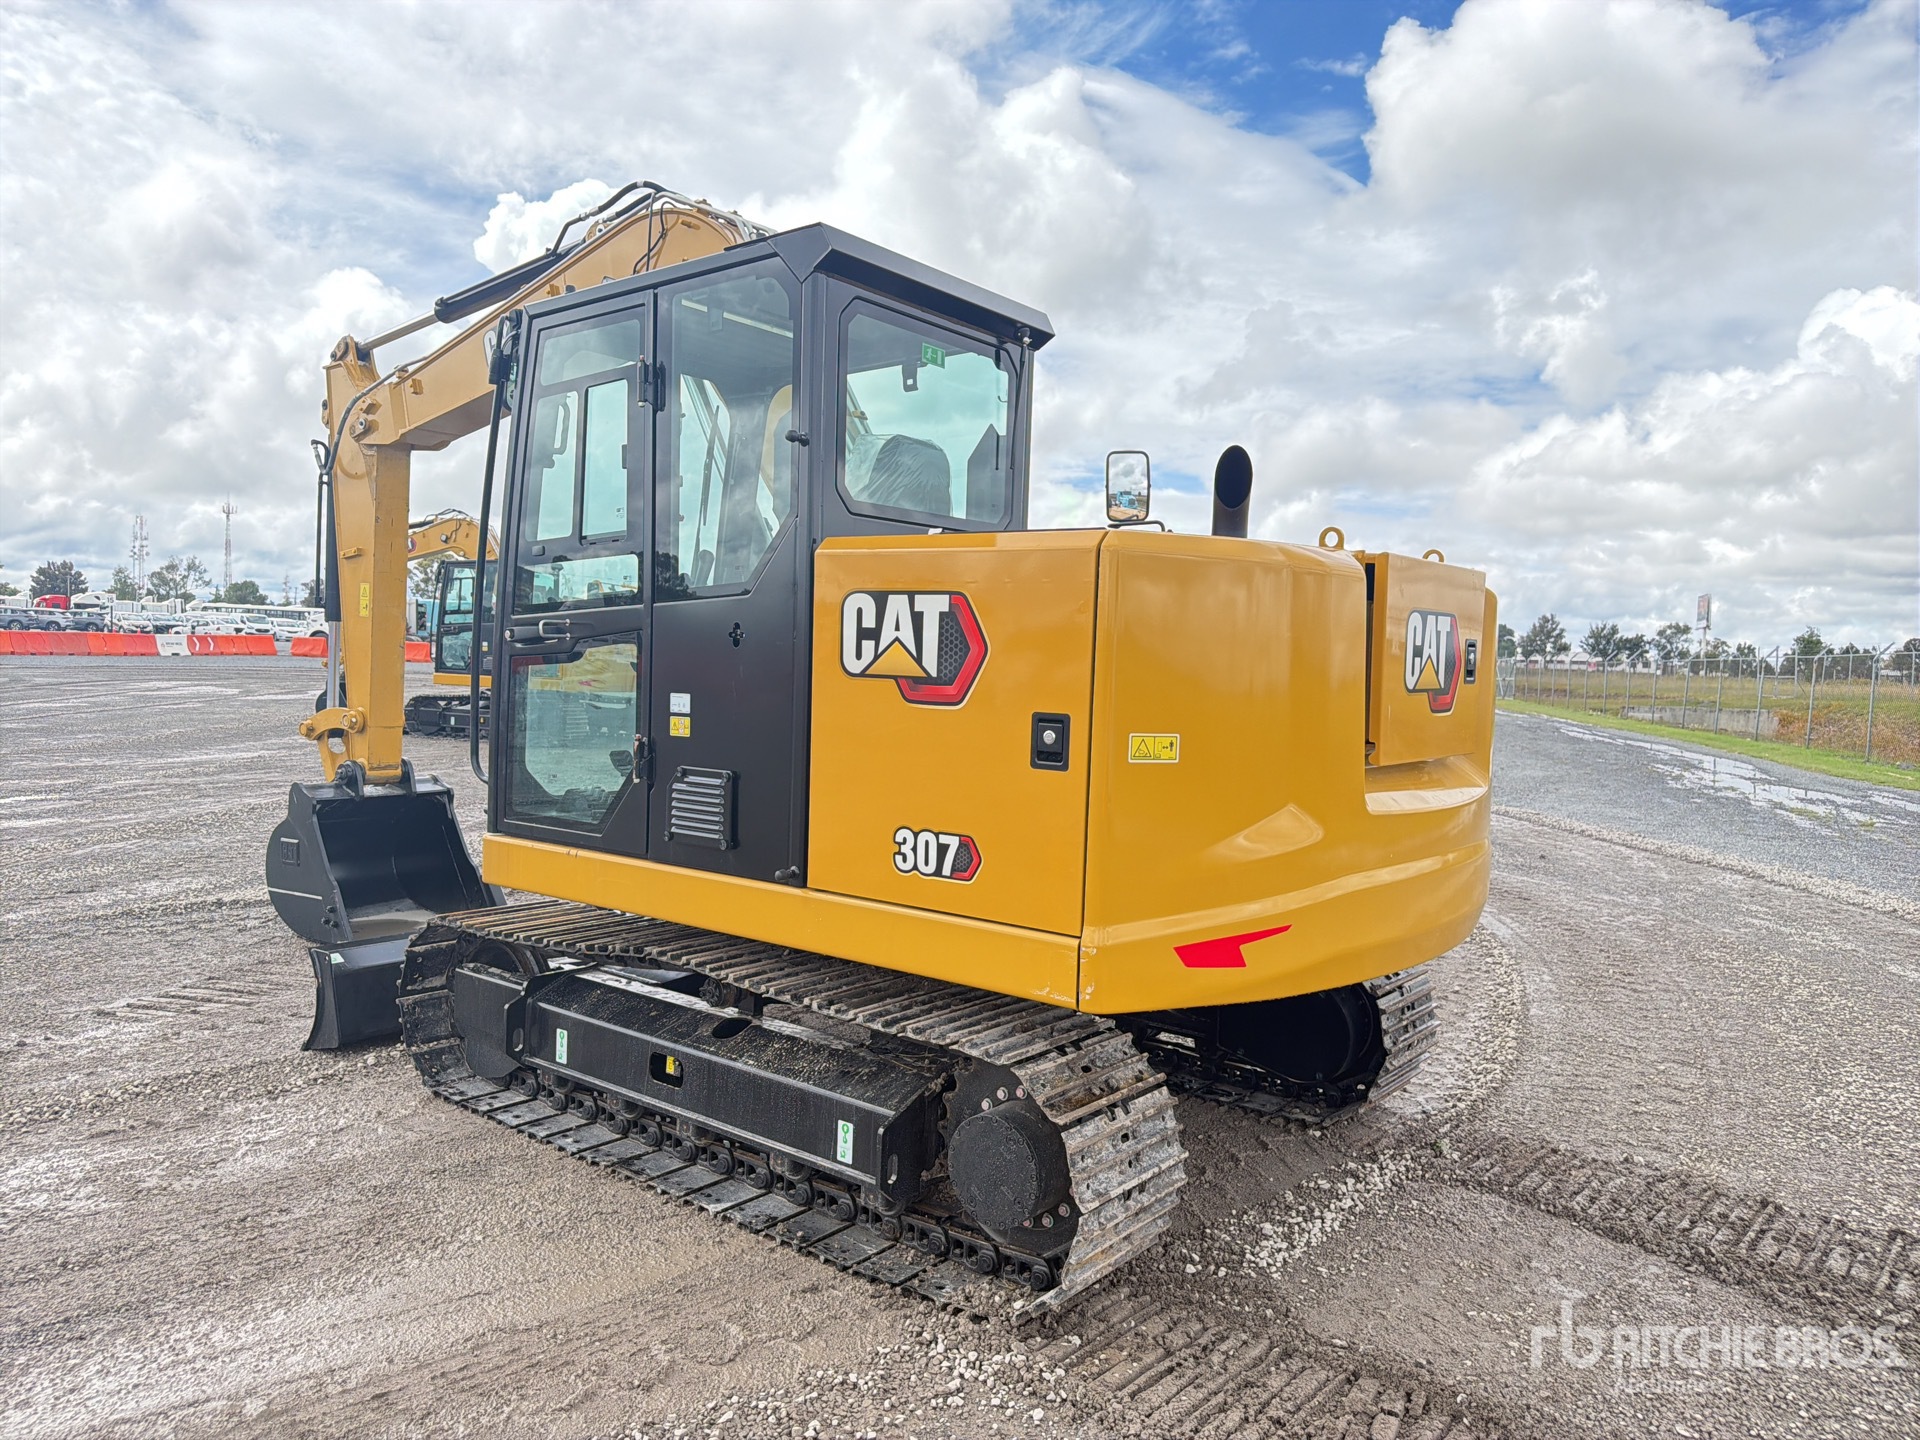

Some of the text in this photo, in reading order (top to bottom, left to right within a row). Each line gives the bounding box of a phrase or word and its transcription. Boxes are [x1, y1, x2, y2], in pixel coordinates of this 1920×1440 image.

[842, 592, 950, 678] CAT
[1405, 611, 1451, 690] CAT
[894, 828, 960, 877] 307
